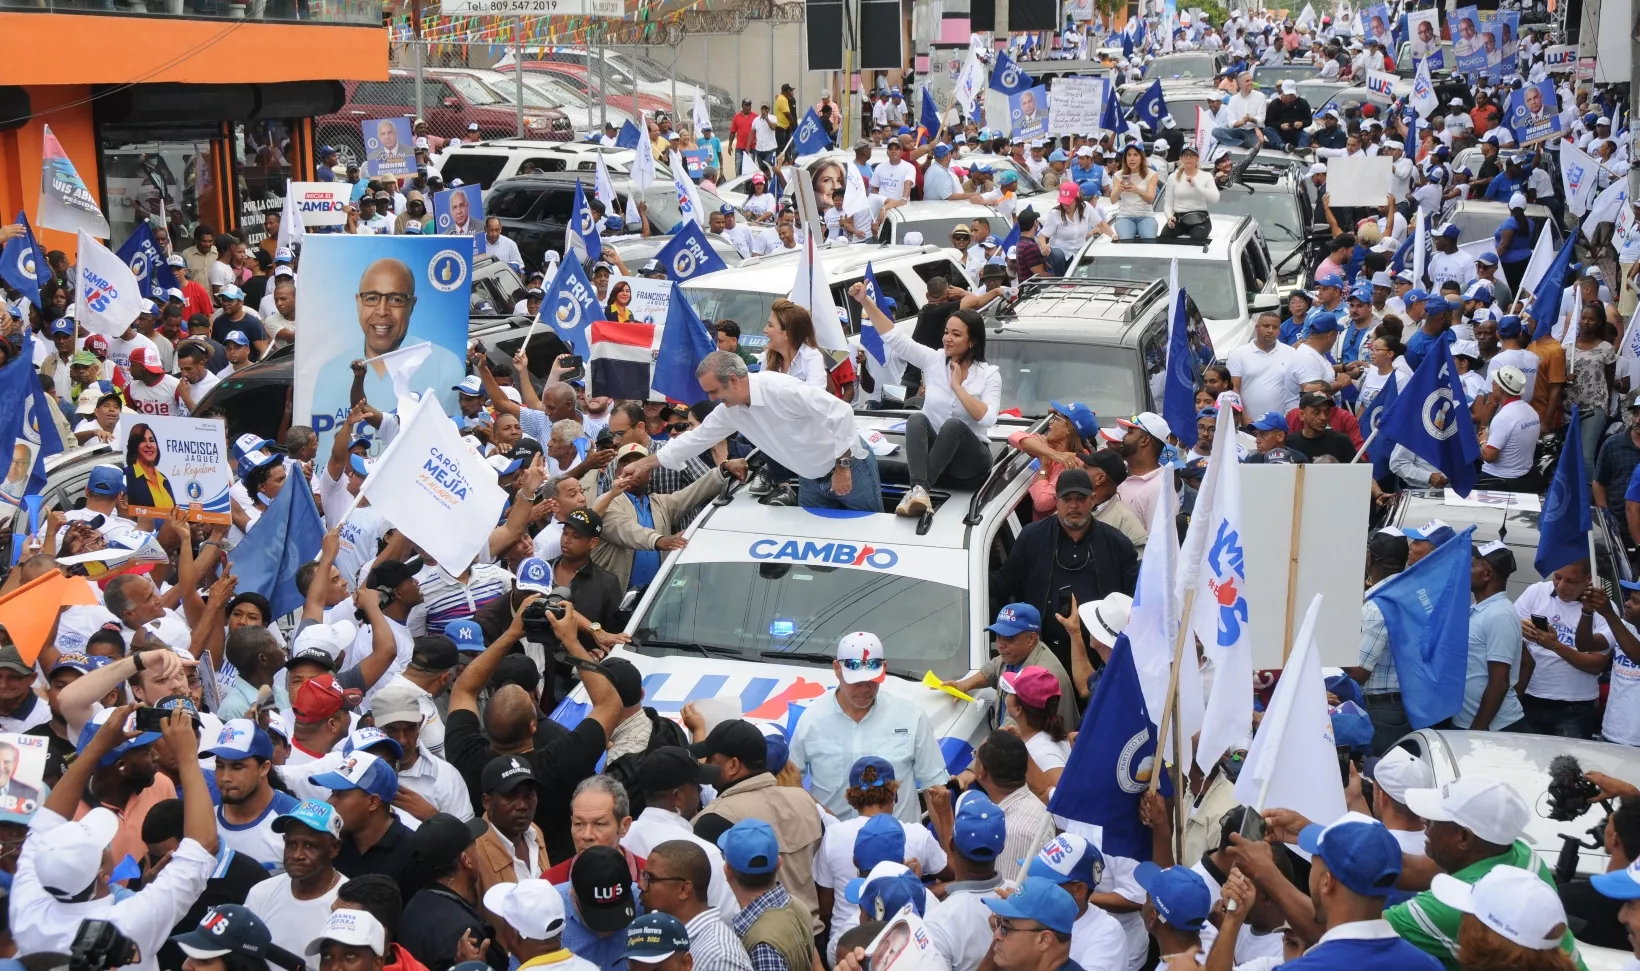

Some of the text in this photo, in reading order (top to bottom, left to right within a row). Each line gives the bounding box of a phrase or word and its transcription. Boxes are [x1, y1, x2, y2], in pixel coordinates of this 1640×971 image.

[1547, 49, 1577, 64] LUIS
[1005, 60, 1023, 74] PRM
[1368, 76, 1393, 95] LUIS
[806, 116, 819, 134] PRM
[52, 178, 75, 196] LUIS
[306, 192, 325, 200] INICIA
[243, 198, 258, 212] POR
[258, 198, 266, 210] LA
[297, 200, 344, 212] CAMBIO
[247, 213, 255, 224] UN
[141, 238, 164, 267] PRM
[685, 236, 709, 265] PRM
[83, 267, 118, 300] CAMBIO
[565, 274, 594, 309] PRM
[636, 290, 670, 302] FRANCISCA
[166, 439, 219, 456] FRANCISCA
[184, 455, 219, 464] JAQUEZ
[184, 462, 217, 477] Regidora
[423, 458, 467, 501] MEJÍA
[433, 494, 452, 511] NACIONAL
[748, 538, 899, 569] CAMBIO
[17, 736, 43, 748] LUIS
[1119, 741, 1138, 772] PARTIDO
[594, 883, 623, 900] LUIS
[199, 910, 230, 935] UIS
[914, 927, 929, 950] LUIS
